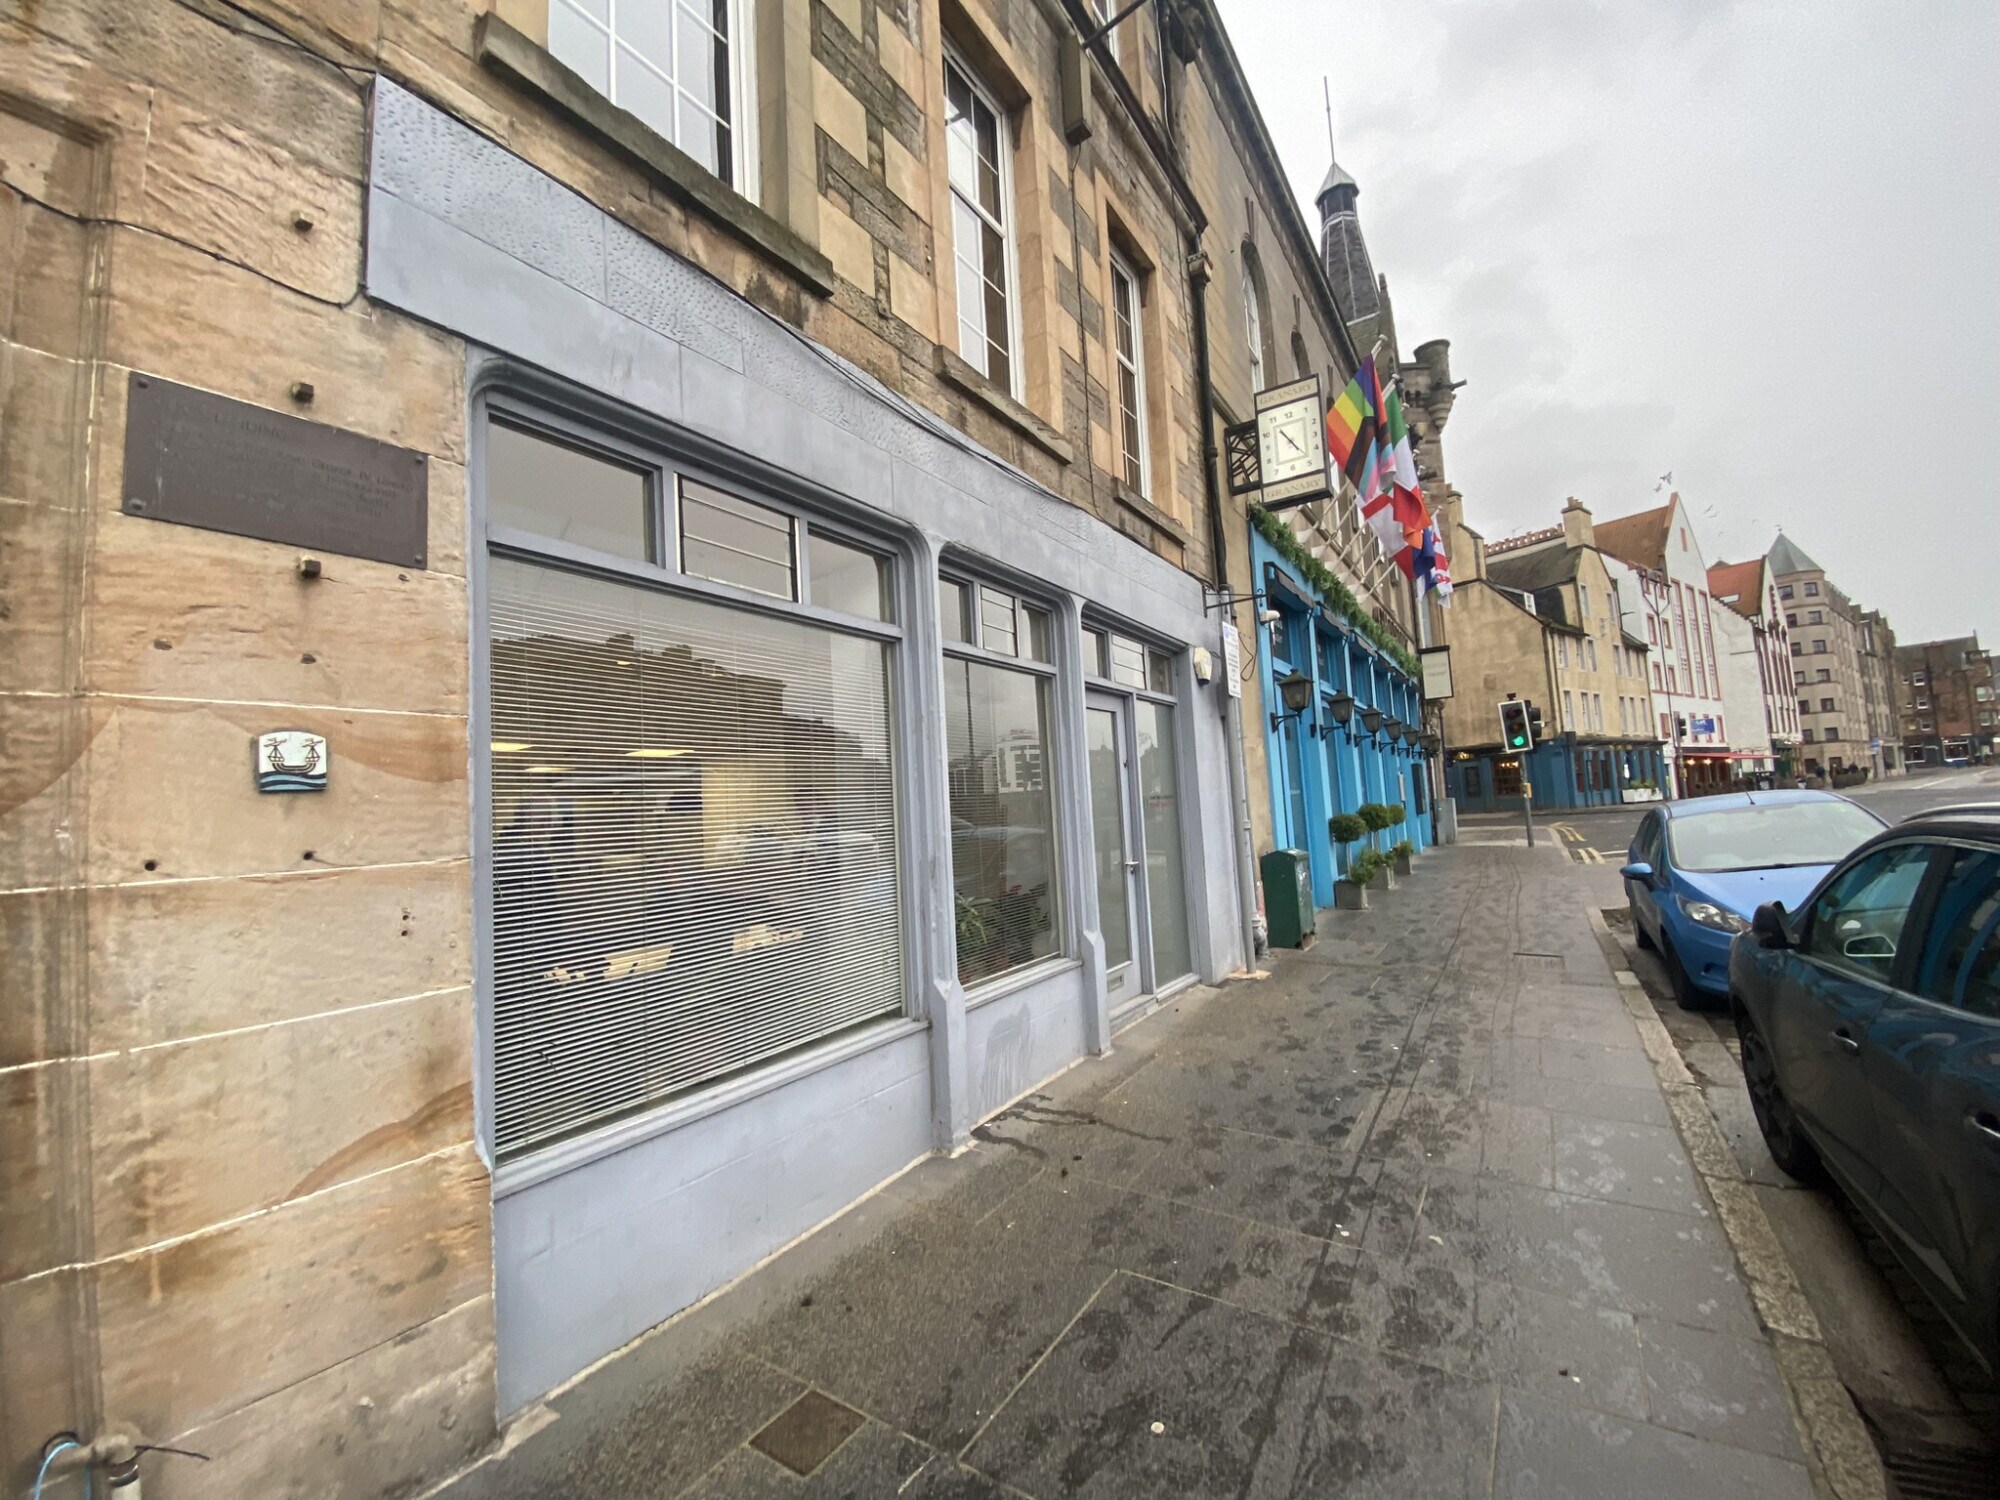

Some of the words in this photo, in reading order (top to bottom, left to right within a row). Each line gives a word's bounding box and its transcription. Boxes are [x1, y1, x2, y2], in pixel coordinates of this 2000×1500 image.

[1260, 382, 1314, 405] GRANARY
[1269, 416, 1277, 424] 11
[1284, 411, 1293, 420] 12
[1262, 431, 1271, 439] 10
[1266, 479, 1321, 499] GRANARY
